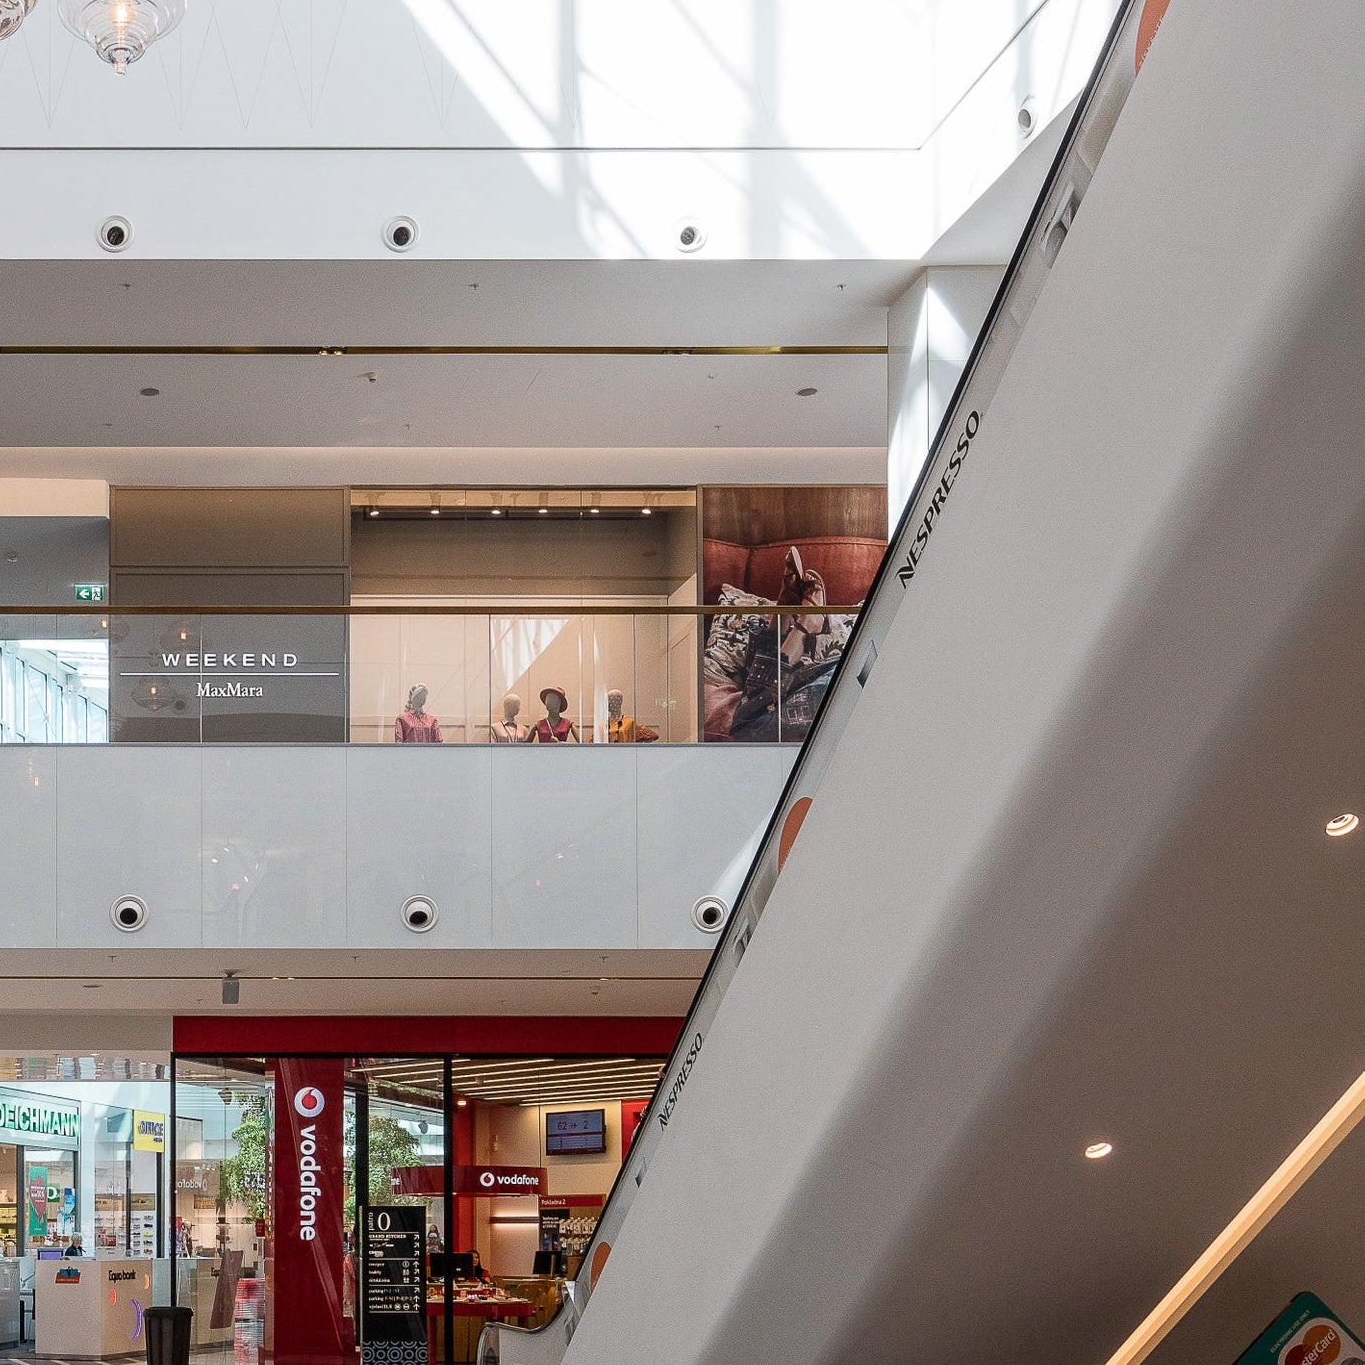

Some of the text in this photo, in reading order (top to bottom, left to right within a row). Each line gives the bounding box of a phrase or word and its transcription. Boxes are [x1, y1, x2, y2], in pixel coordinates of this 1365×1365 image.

[894, 410, 980, 590] NESPRESSO
[162, 654, 297, 667] WEEKEND
[196, 683, 264, 697] MaxMara
[657, 1032, 703, 1132] NESPRESSO
[583, 1120, 589, 1129] 2
[300, 1124, 322, 1241] vodafone
[496, 1174, 539, 1186] vodafone
[377, 1212, 391, 1231] 0
[108, 1269, 136, 1283] Equa bank
